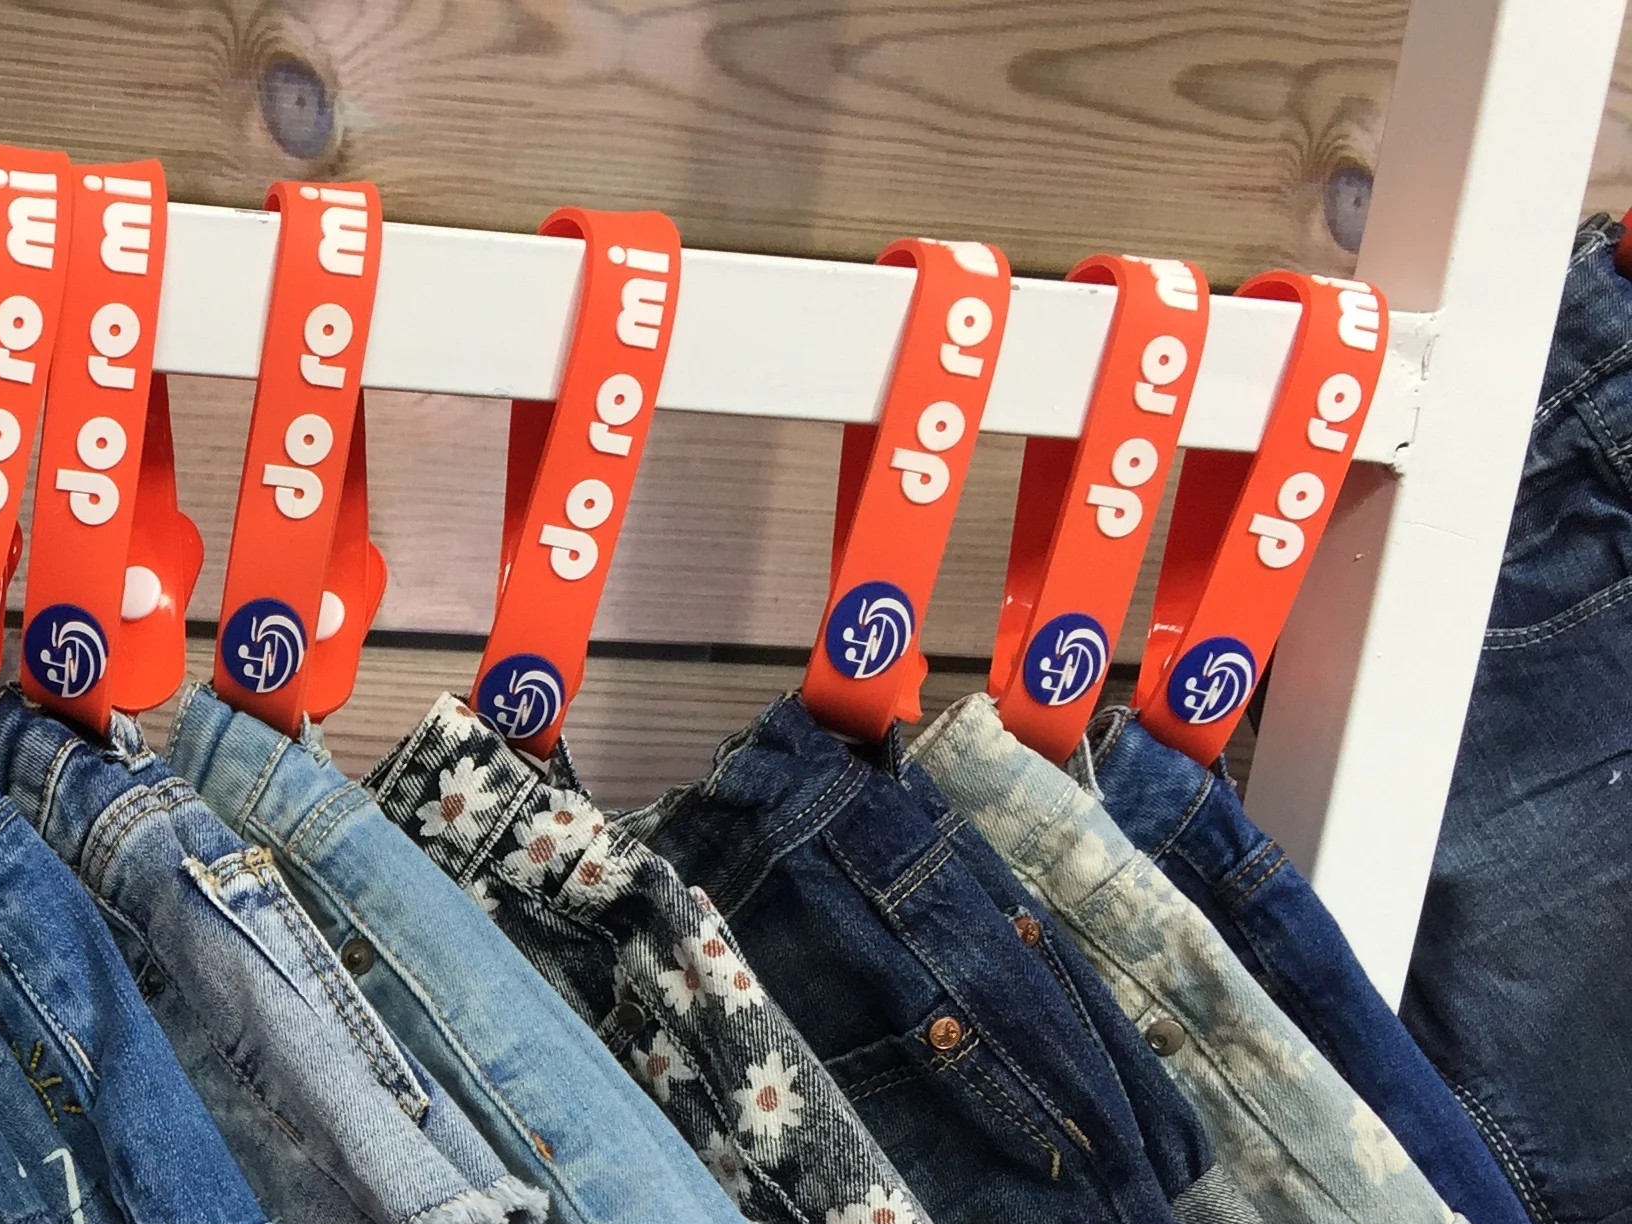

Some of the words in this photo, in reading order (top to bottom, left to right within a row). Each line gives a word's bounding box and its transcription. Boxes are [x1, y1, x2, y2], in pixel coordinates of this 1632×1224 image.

[83, 175, 152, 274] mi
[299, 186, 367, 275] mi
[87, 303, 140, 389] ro
[300, 304, 353, 388] ro
[607, 246, 669, 349] mi
[589, 374, 642, 456] ro
[892, 402, 965, 503] do
[940, 297, 992, 377] ro
[1087, 438, 1158, 537] do
[1135, 336, 1187, 414] ro
[55, 417, 126, 524] do
[262, 414, 333, 518] do
[1249, 472, 1325, 568] do
[1308, 374, 1361, 451] ro
[539, 480, 613, 579] do
